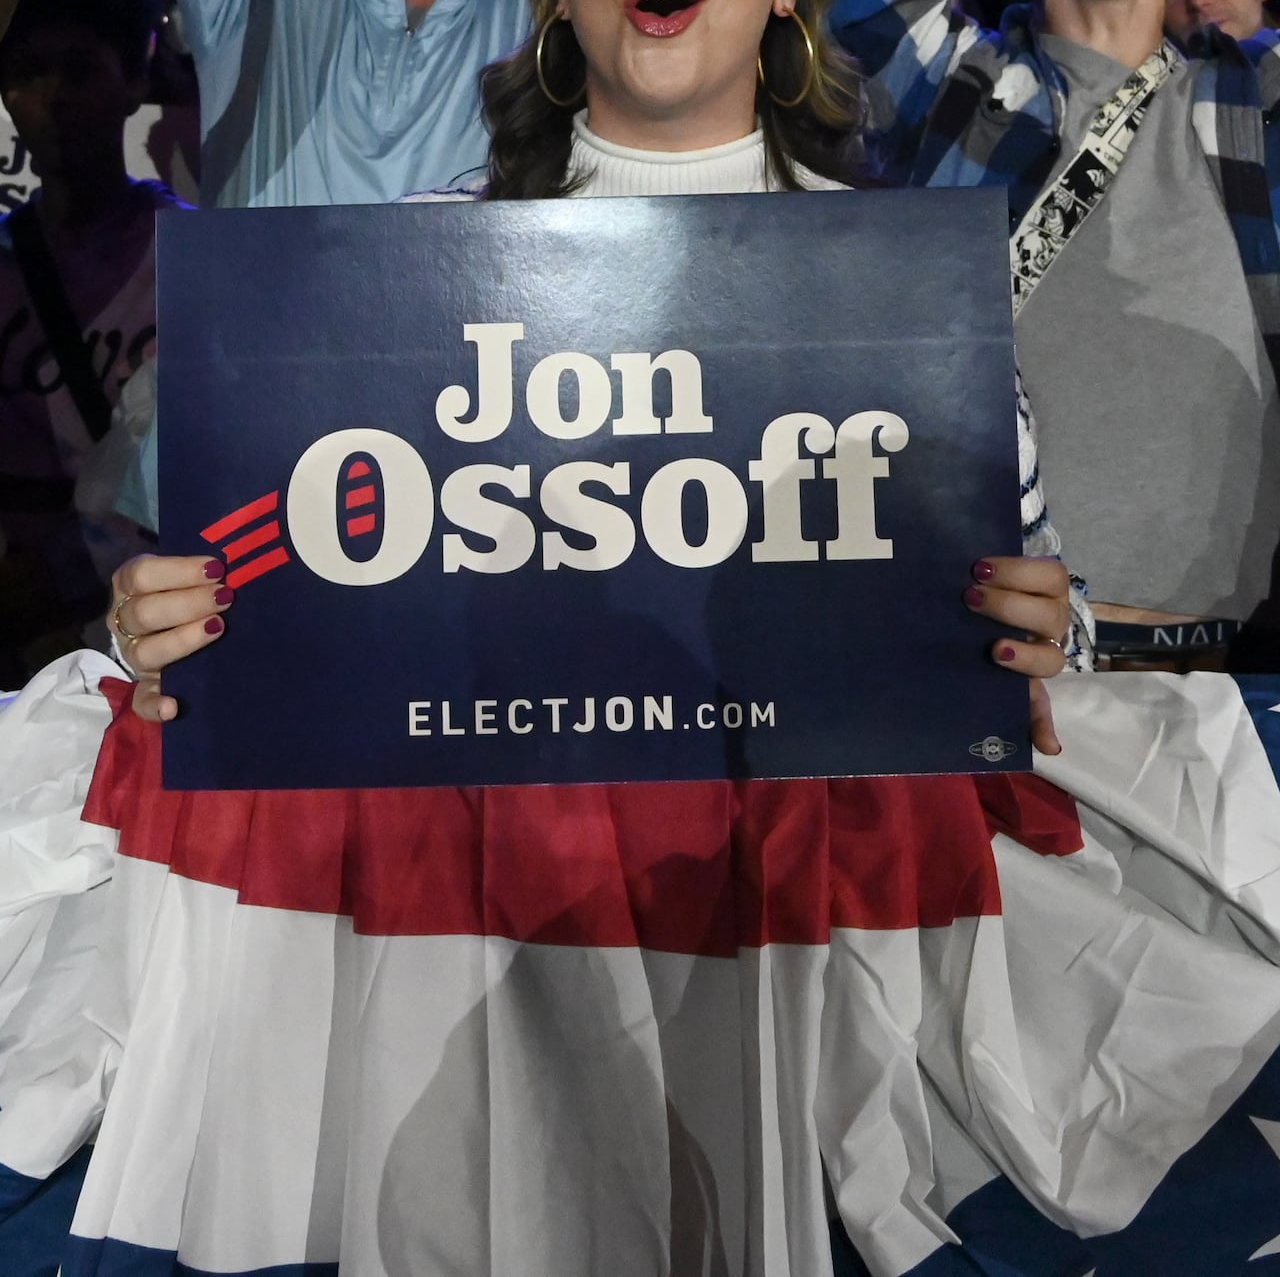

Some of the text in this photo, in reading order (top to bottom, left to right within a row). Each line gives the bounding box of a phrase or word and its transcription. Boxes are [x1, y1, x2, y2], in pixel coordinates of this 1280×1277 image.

[435, 322, 712, 443] Jon
[286, 411, 909, 586] Ossoff
[408, 696, 776, 737] ELECTJON.COM
